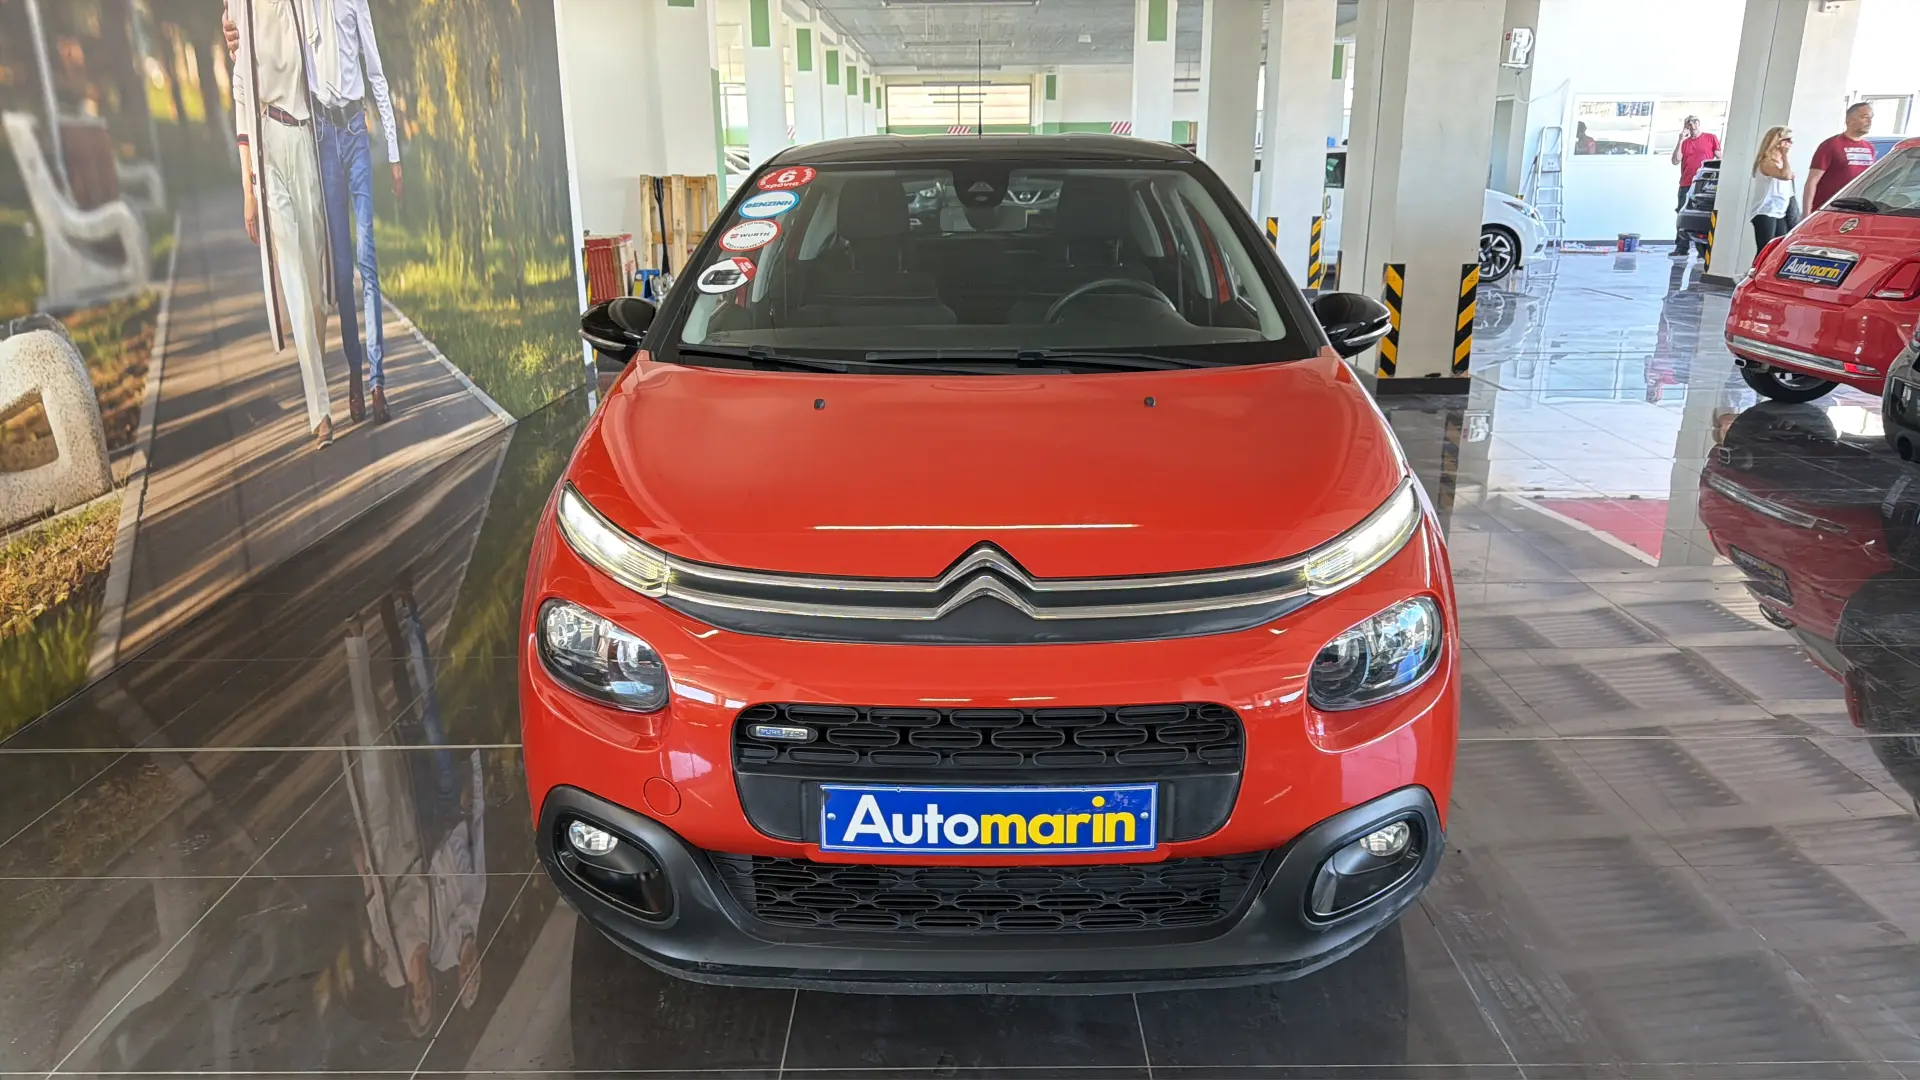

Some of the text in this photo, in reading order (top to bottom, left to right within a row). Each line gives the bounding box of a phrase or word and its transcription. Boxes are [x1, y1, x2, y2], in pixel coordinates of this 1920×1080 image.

[778, 172, 797, 183] 6
[1784, 258, 1840, 279] Automarin
[842, 794, 1136, 845] Automarin
